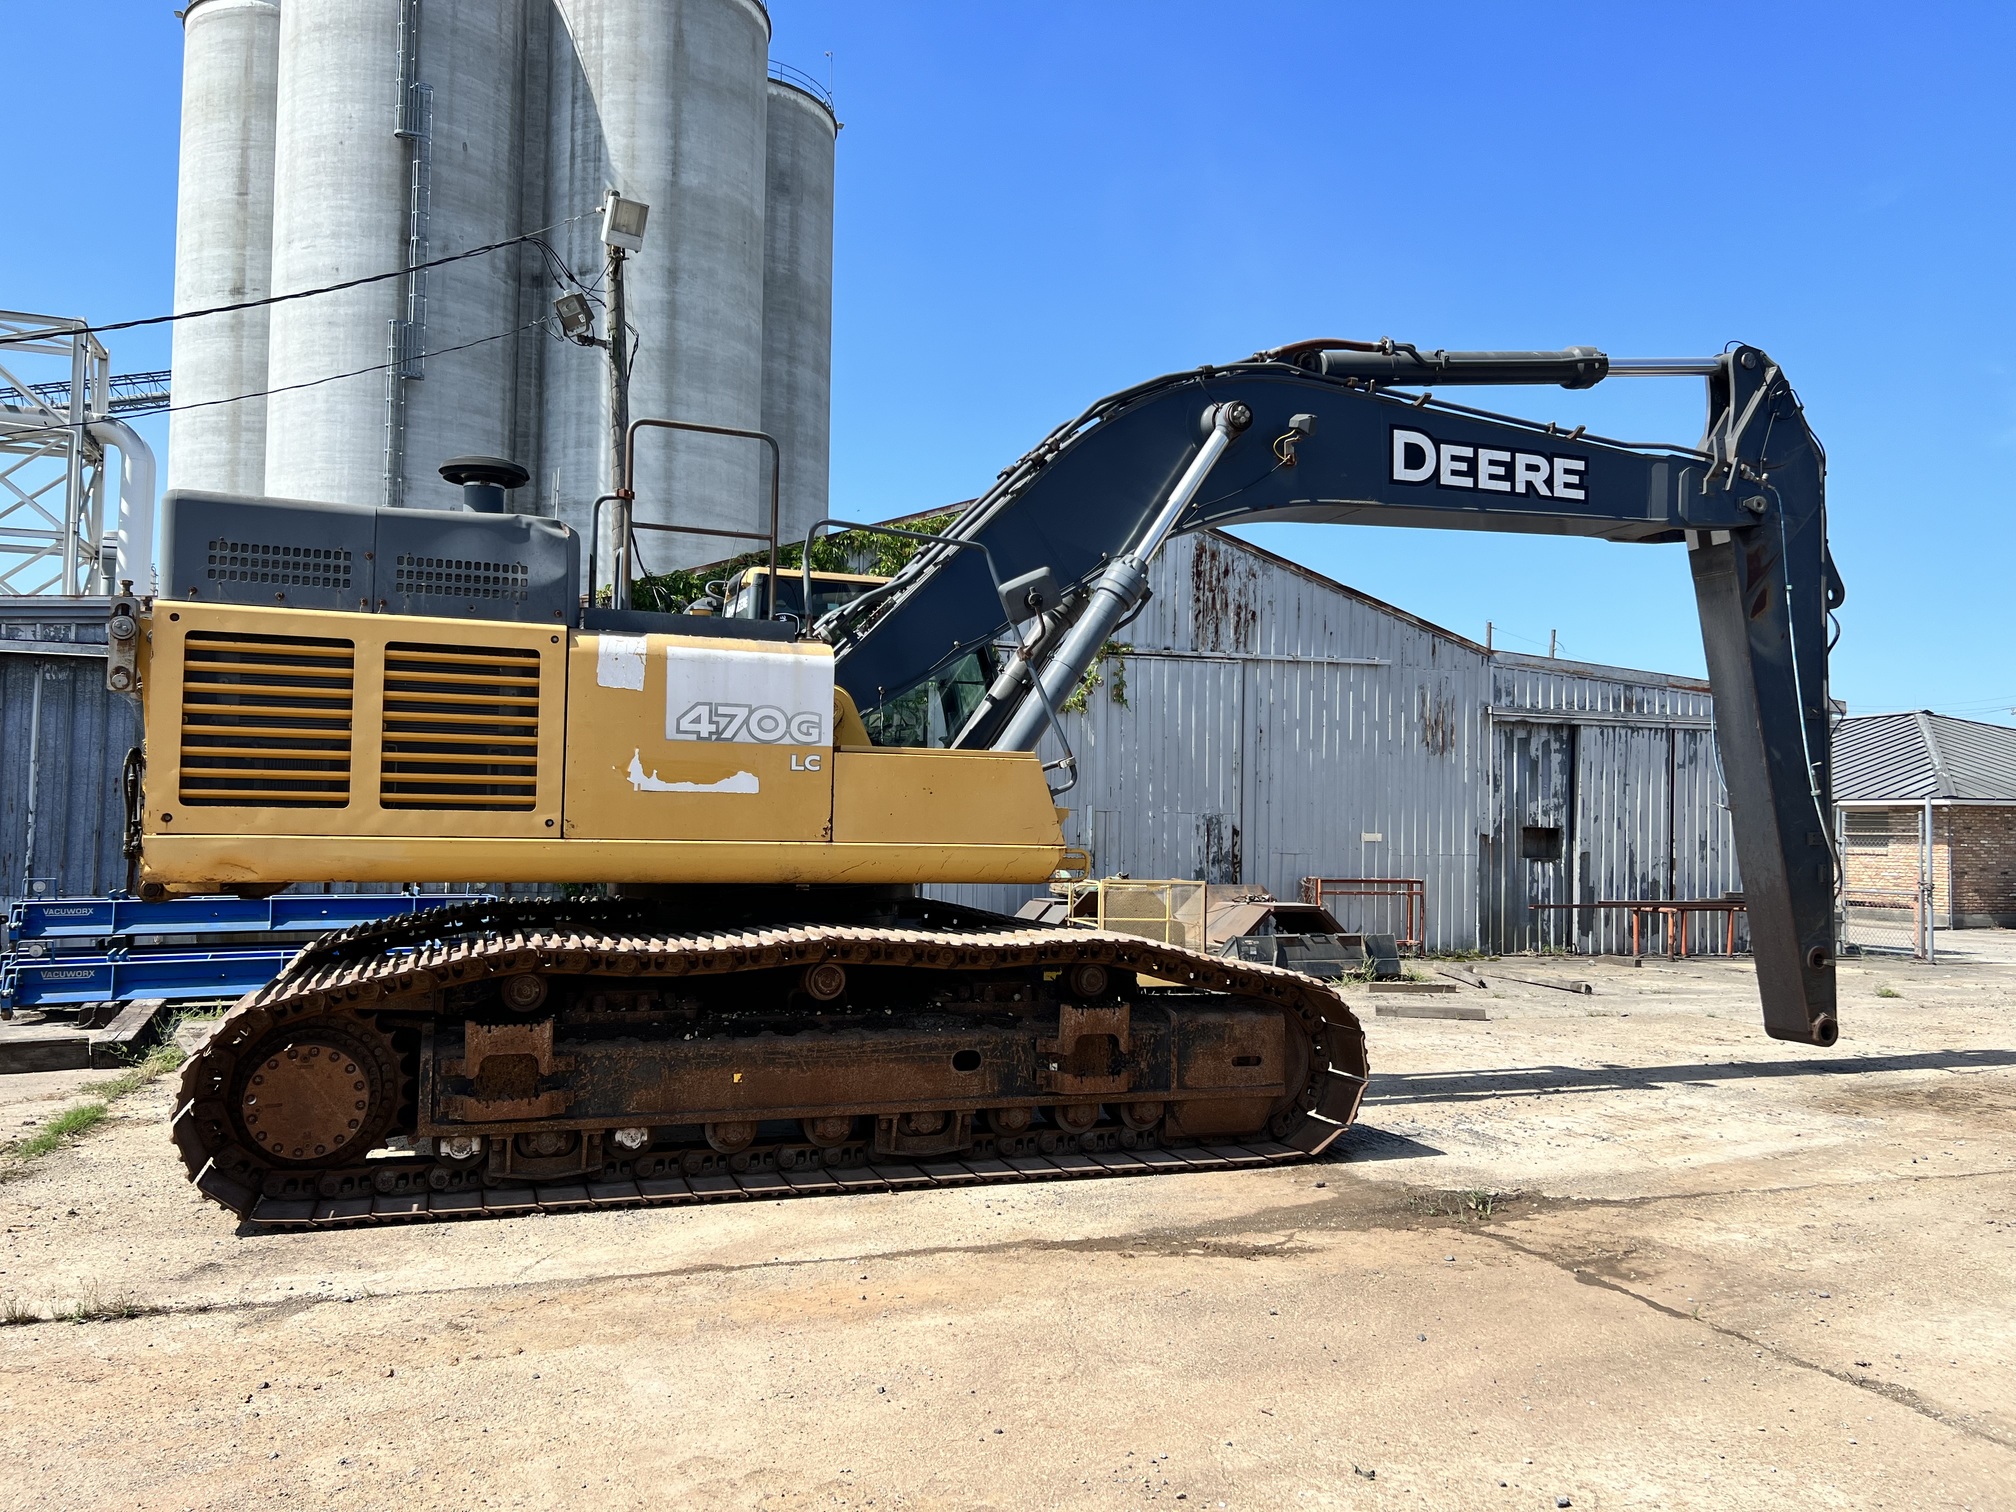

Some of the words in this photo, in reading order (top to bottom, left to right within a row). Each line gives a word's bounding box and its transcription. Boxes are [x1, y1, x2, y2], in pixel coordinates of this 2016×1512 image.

[1393, 429, 1585, 500] DEERE
[676, 701, 823, 745] 470G
[790, 753, 821, 772] LC
[43, 907, 94, 916] VACUWORX
[41, 970, 95, 979] VACUWORX
